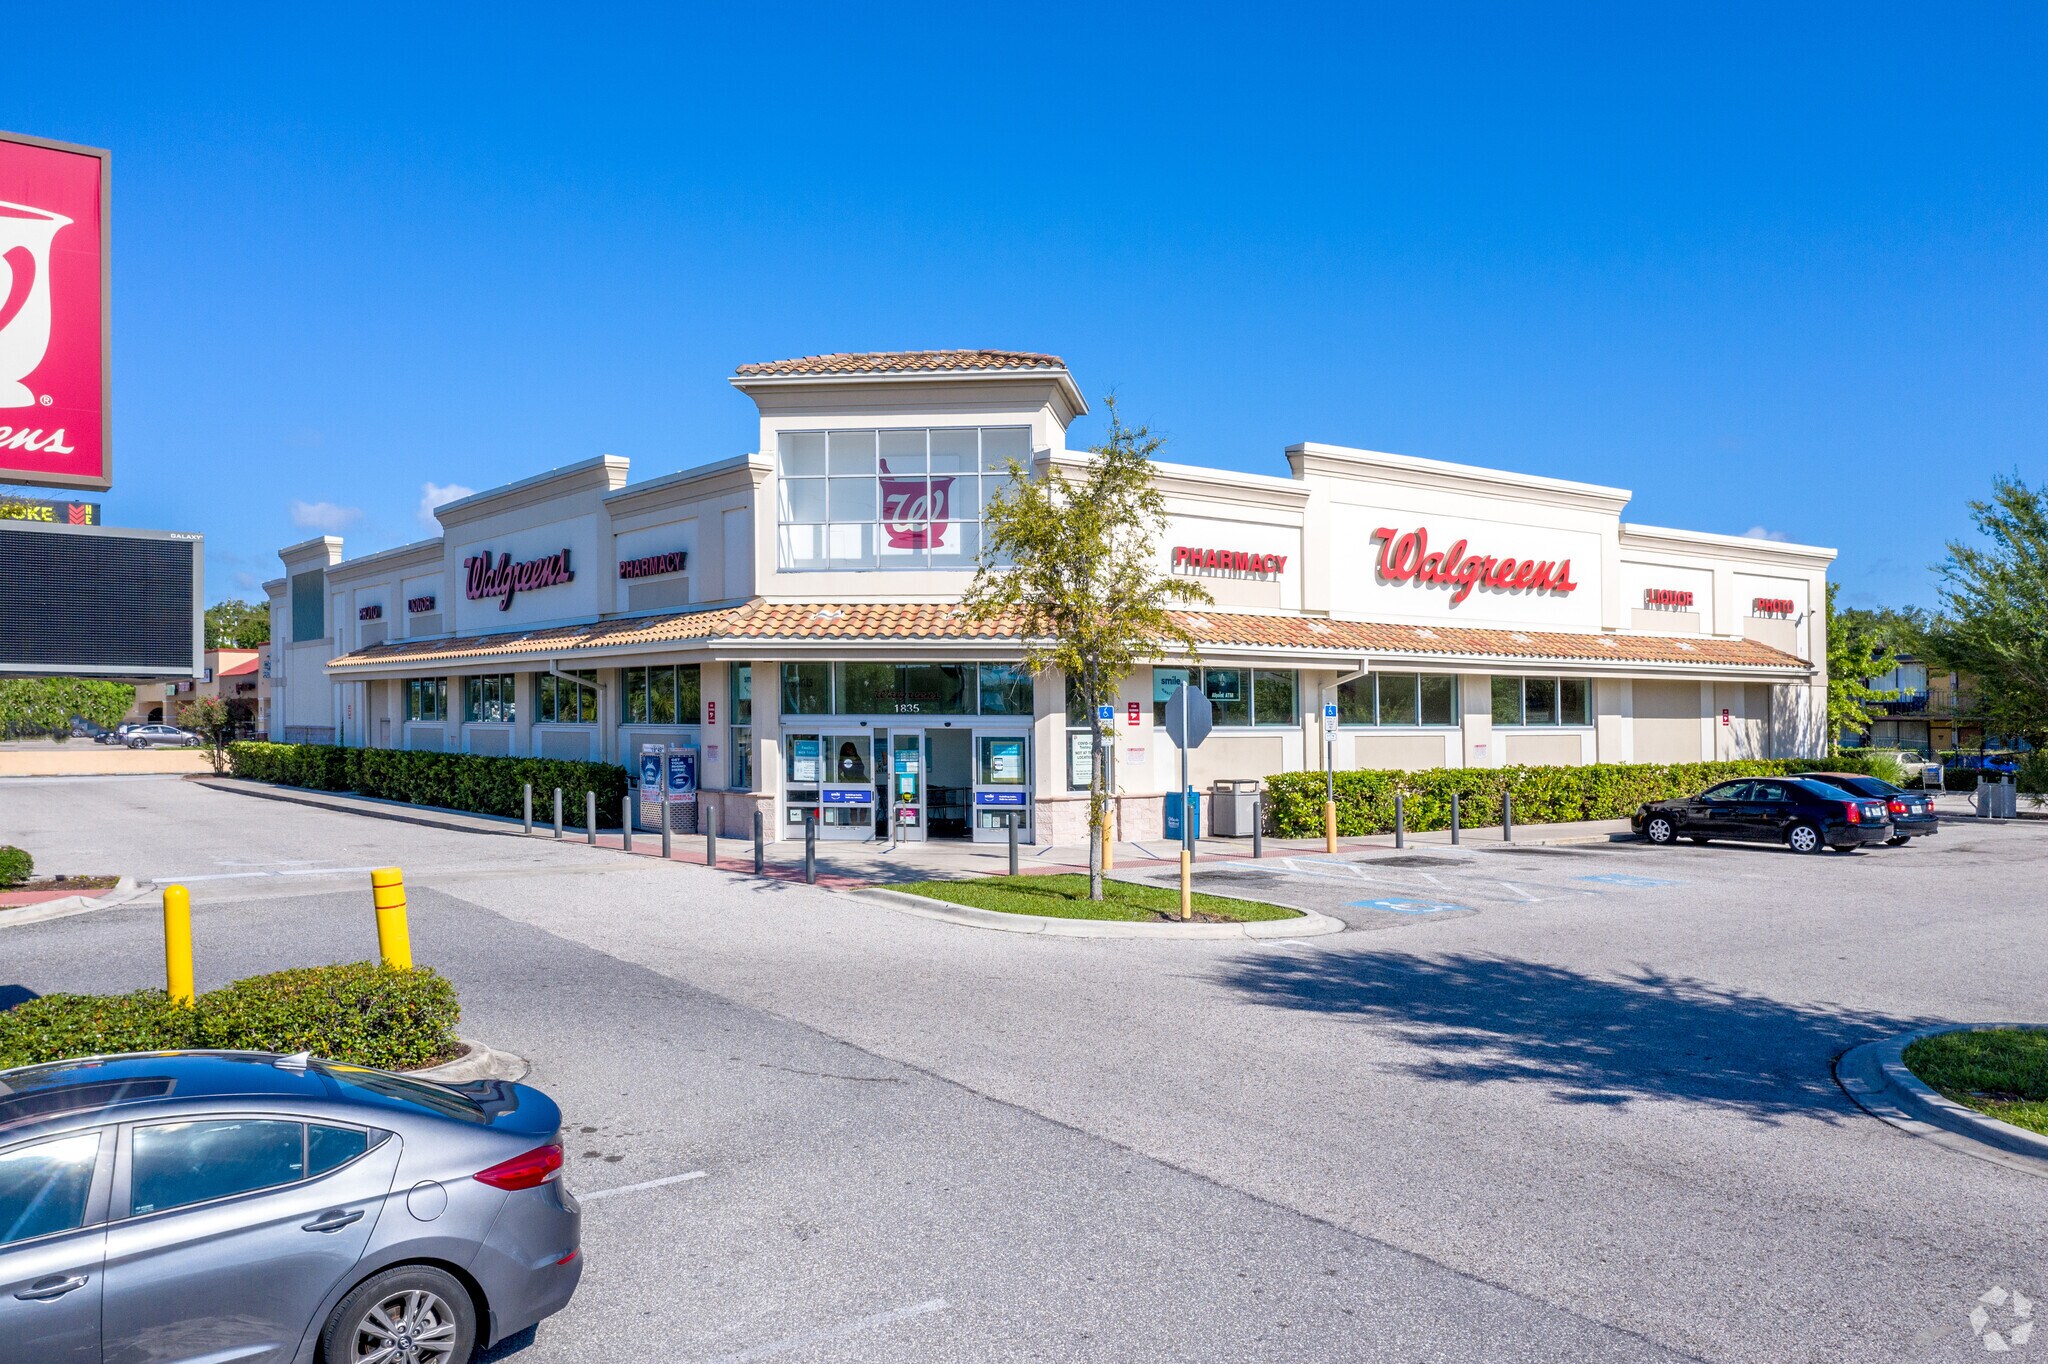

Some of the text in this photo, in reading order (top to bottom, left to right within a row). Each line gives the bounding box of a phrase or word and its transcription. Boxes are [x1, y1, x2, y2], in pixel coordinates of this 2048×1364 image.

[619, 552, 687, 579] PHARMACY
[1174, 546, 1288, 574] PHARMACY
[1372, 526, 1578, 604] Walgreens
[464, 548, 574, 611] Walgreens
[1649, 588, 1694, 606] LIQUOR
[1757, 597, 1795, 614] PHOTO
[1161, 675, 1181, 685] smile
[894, 703, 920, 713] 1835
